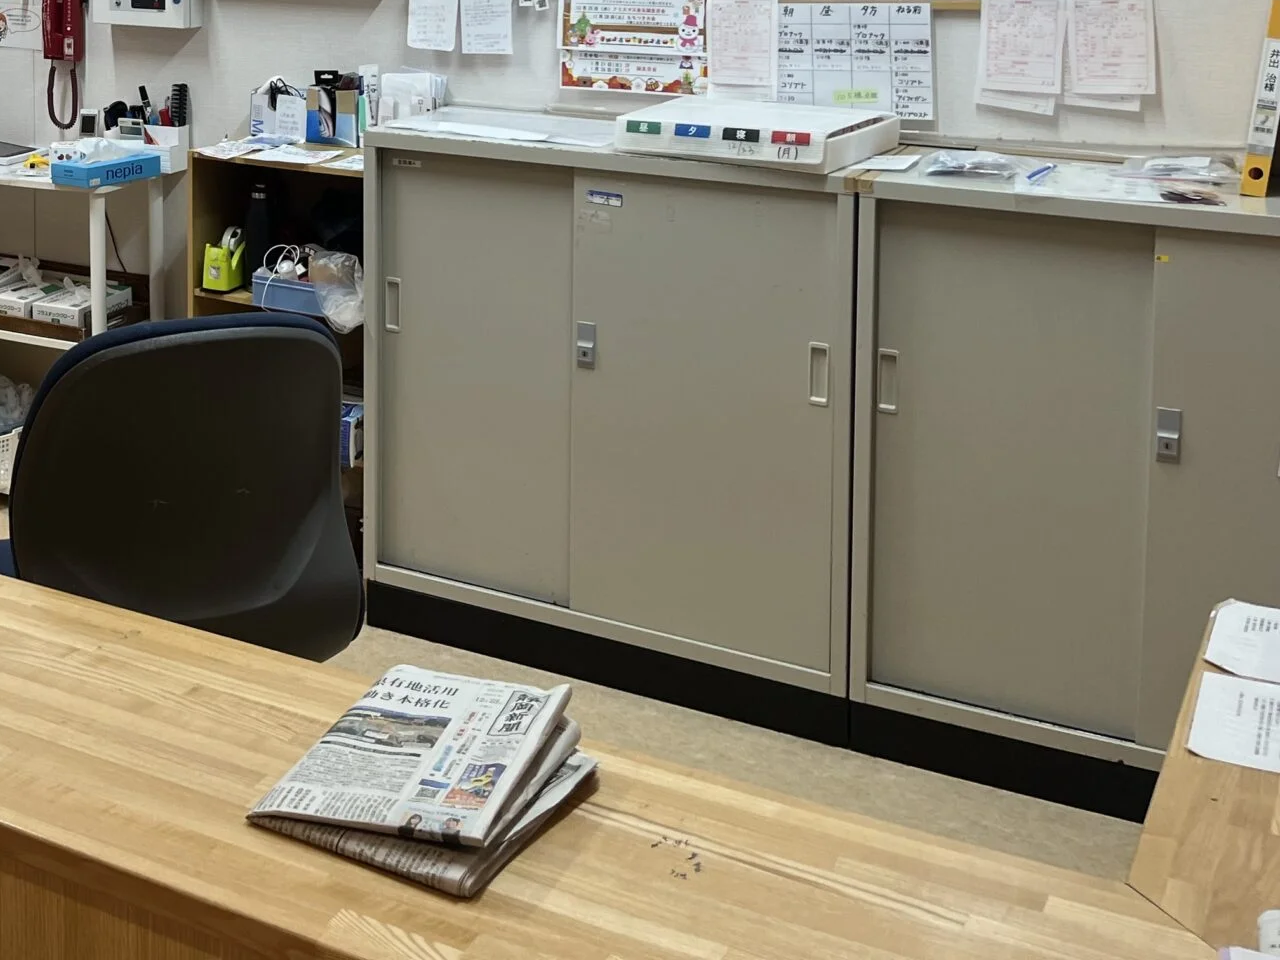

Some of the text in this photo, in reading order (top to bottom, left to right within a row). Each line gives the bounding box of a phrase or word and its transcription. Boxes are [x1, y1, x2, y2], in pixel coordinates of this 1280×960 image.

[782, 6, 922, 18] 朝 昼 夕方 ねる前
[640, 122, 648, 132] 昼
[688, 126, 696, 135] 夕
[736, 129, 746, 139] 寝
[777, 146, 799, 160] (月)
[106, 163, 143, 180] nepia
[498, 694, 542, 733] 静岡新聞
